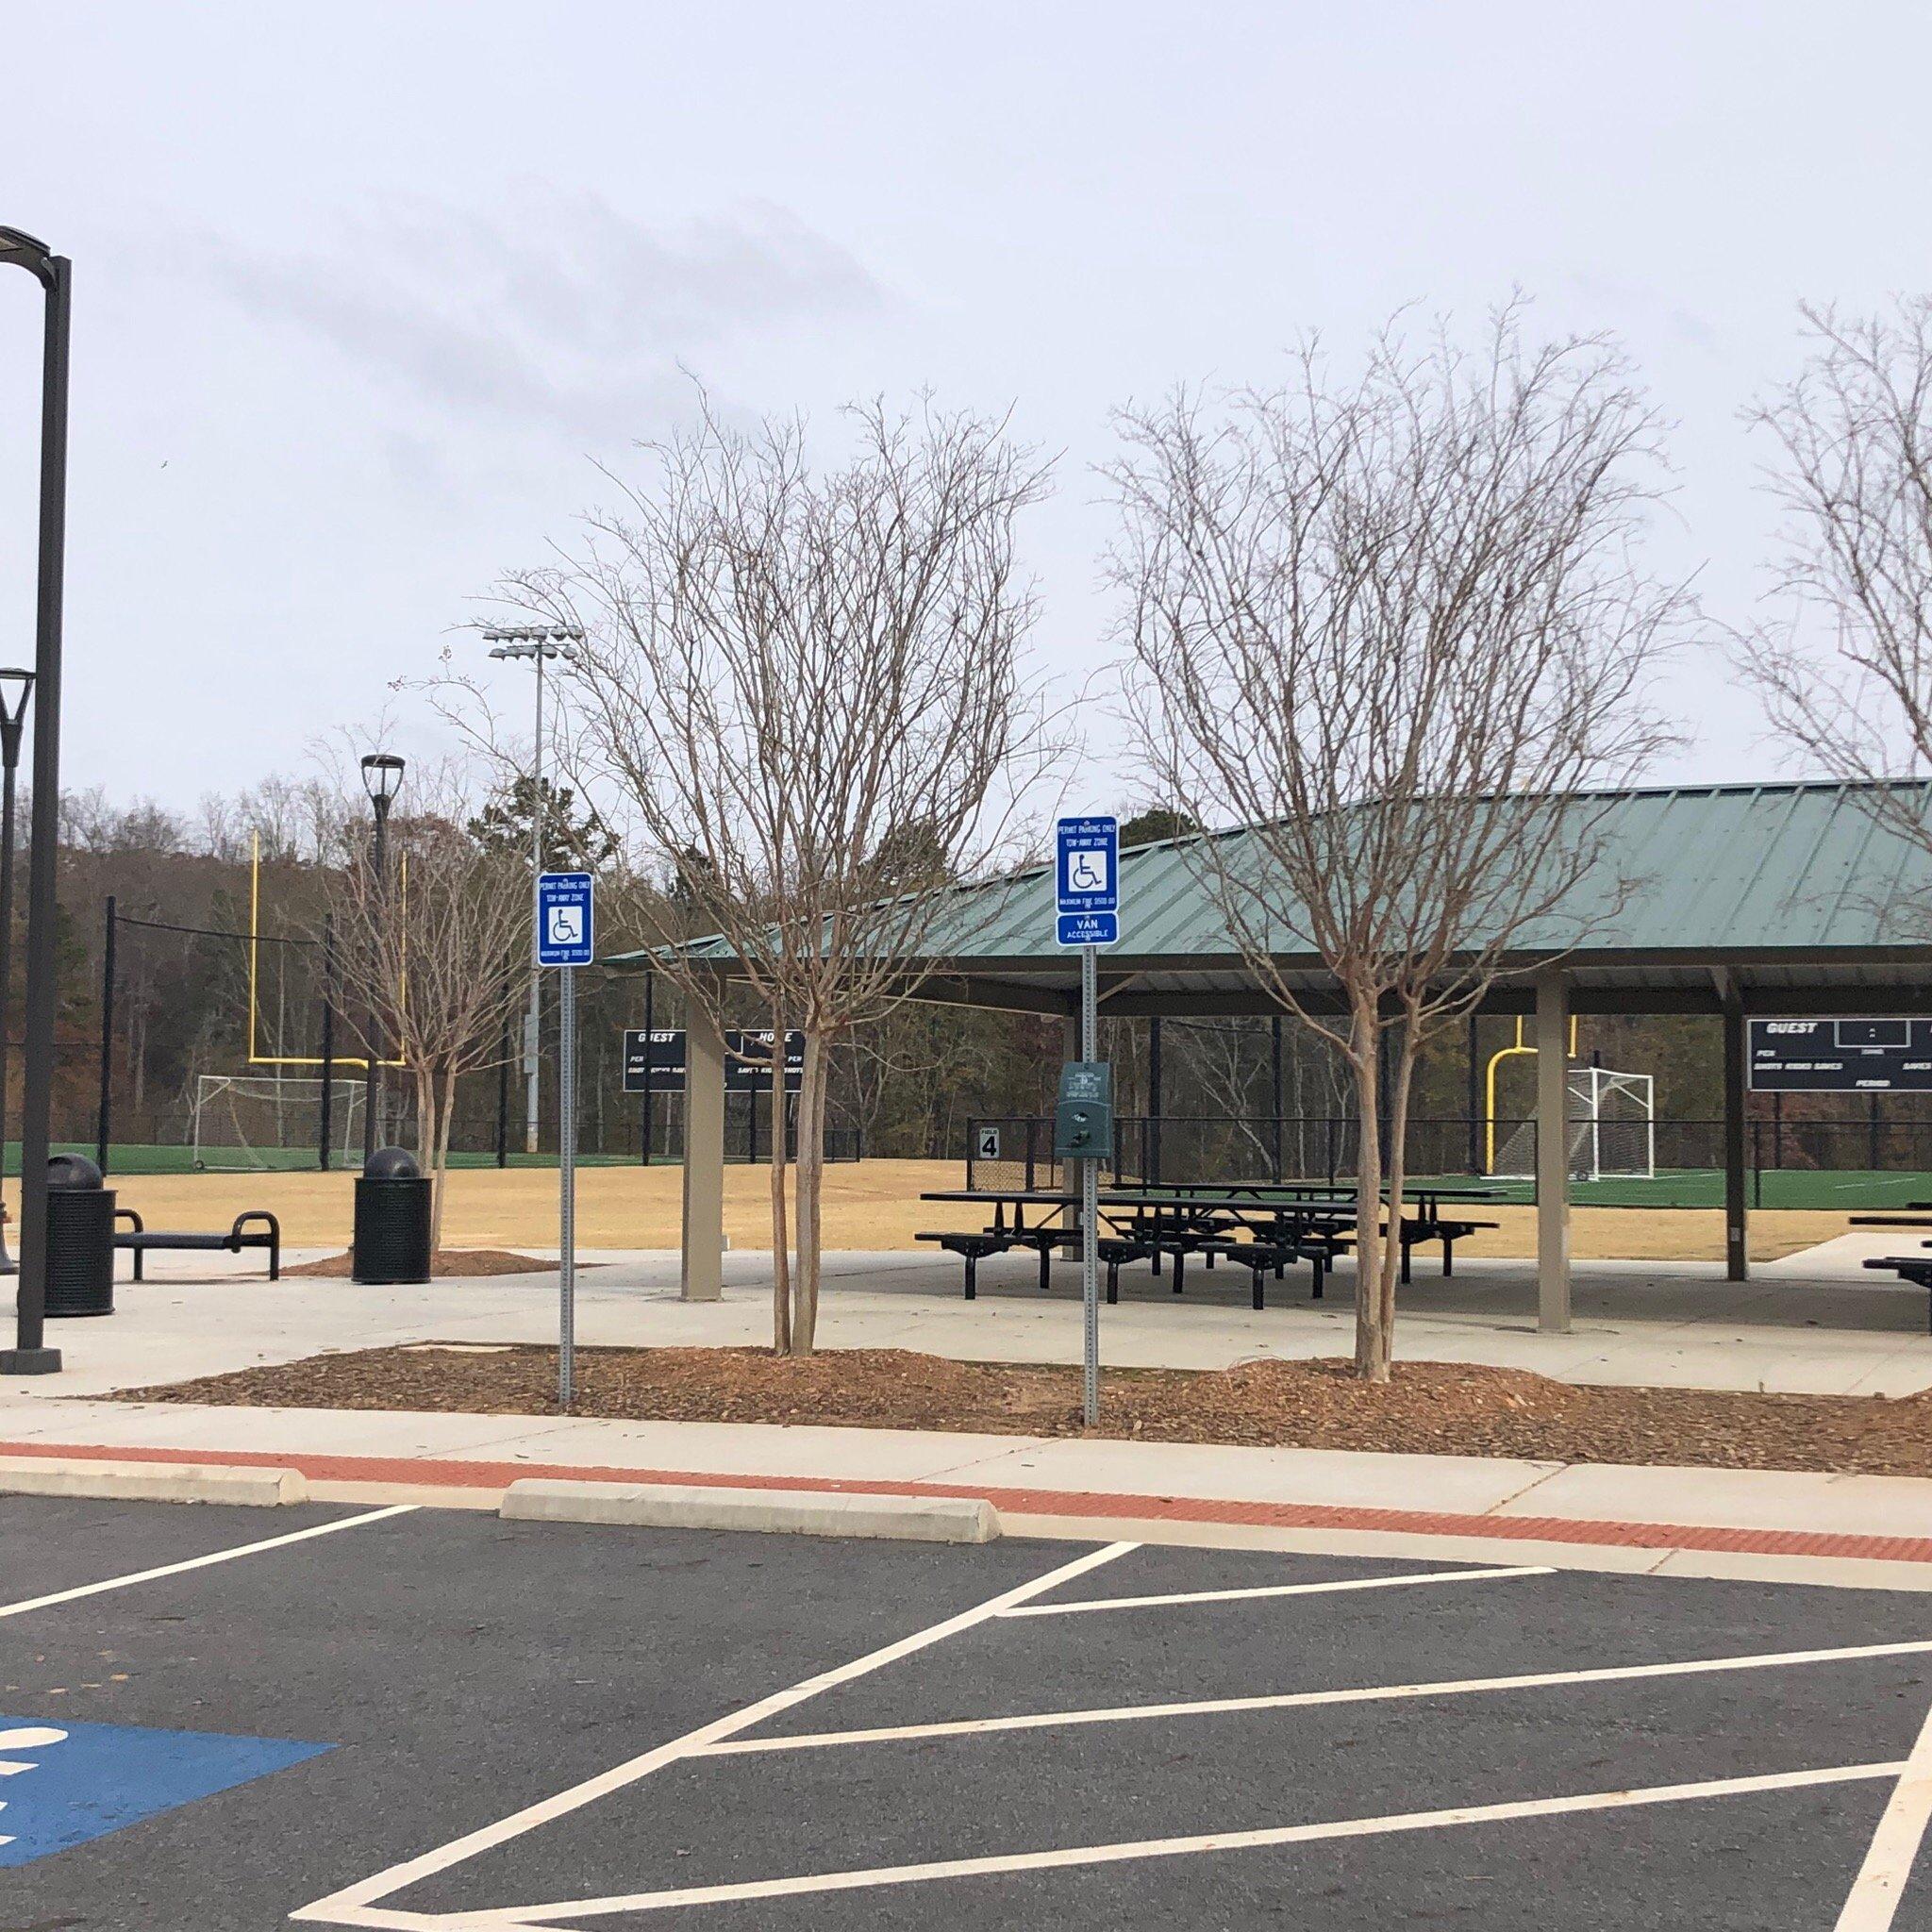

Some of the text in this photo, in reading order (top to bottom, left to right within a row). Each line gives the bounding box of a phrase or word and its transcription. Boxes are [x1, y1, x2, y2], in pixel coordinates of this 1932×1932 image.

[1078, 824, 1101, 833] PARKING
[1102, 824, 1116, 833] ONLY
[1093, 837, 1108, 846] ZONE
[1076, 919, 1098, 929] VAN
[1066, 929, 1108, 939] ACCESSIBLE
[1766, 1023, 1818, 1034] GUEST
[758, 1032, 792, 1042] HOE
[982, 1136, 997, 1156] 4
